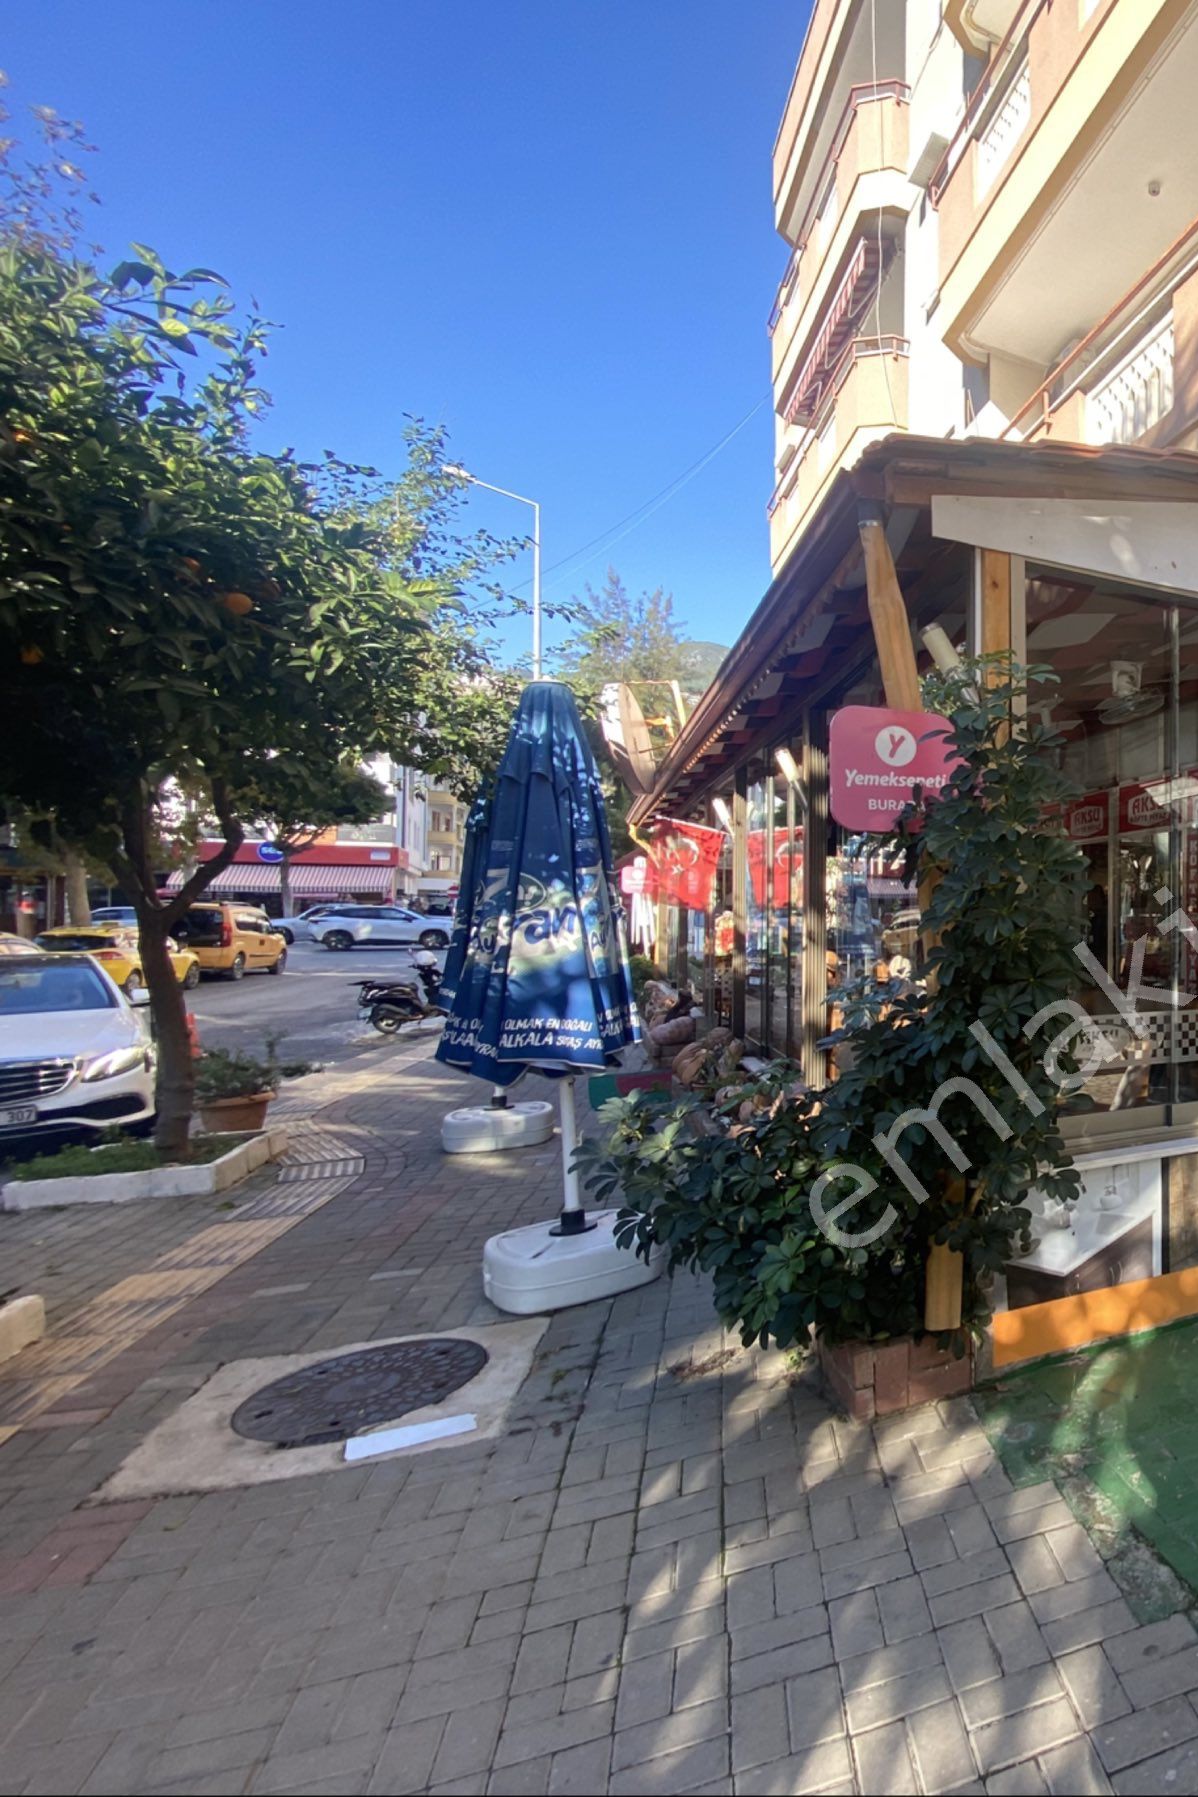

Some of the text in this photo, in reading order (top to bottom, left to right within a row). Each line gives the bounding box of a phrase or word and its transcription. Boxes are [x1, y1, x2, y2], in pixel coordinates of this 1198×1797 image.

[868, 799, 926, 812] BURAA
[1132, 796, 1164, 815] AKS
[1074, 807, 1100, 825] AKSU
